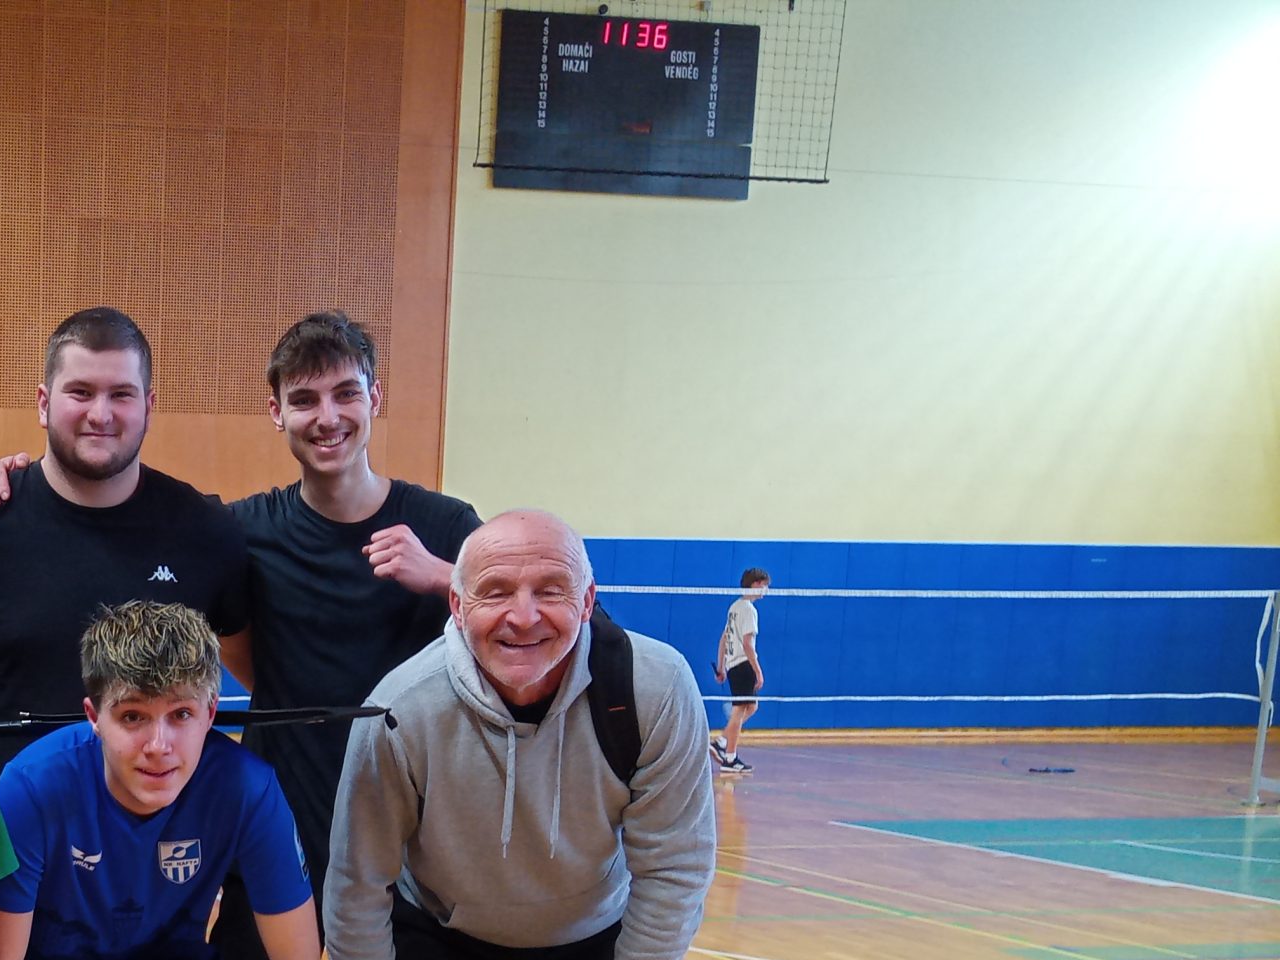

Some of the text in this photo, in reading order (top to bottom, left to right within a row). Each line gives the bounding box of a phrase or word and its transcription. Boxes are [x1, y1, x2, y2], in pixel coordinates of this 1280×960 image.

[544, 17, 549, 26] 4
[543, 27, 549, 35] 5
[714, 28, 720, 37] 4
[543, 36, 548, 44] 6
[714, 38, 719, 46] 5
[542, 45, 548, 54] 7
[713, 47, 719, 55] 6
[542, 54, 548, 63] 8
[670, 50, 696, 63] GOSTI
[713, 56, 718, 64] 7
[541, 64, 547, 72] 9
[562, 59, 589, 73] HAZAI
[712, 65, 718, 74] 8
[540, 73, 548, 81] 10
[711, 74, 717, 83] 9
[539, 82, 548, 91] 11
[710, 83, 718, 92] 10
[539, 92, 547, 100] 12
[709, 92, 717, 101] 11
[538, 101, 546, 109] 13
[708, 101, 716, 110] 12
[538, 110, 546, 118] 14
[708, 111, 715, 119] 13
[537, 119, 545, 128] 15
[707, 120, 715, 128] 14
[706, 128, 714, 138] 15
